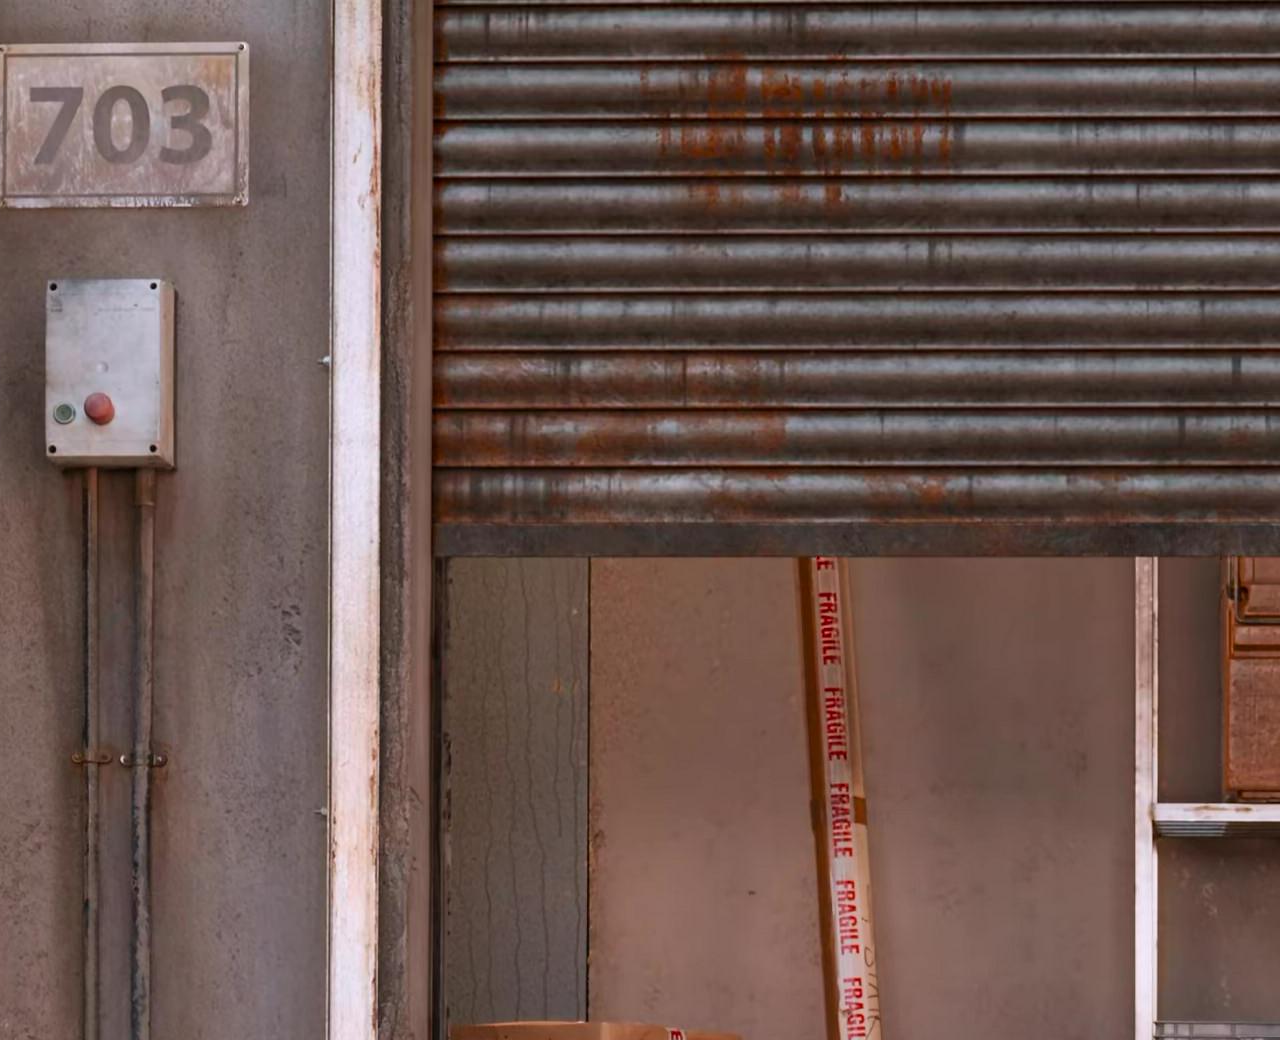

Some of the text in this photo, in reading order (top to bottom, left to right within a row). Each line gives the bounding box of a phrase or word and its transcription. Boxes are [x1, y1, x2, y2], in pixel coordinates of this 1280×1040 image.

[29, 84, 213, 165] 703
[818, 592, 842, 665] FRAGILE
[824, 687, 848, 761] FRAGILE
[830, 782, 853, 858] FRAGILE
[836, 879, 860, 956] FRAGILE
